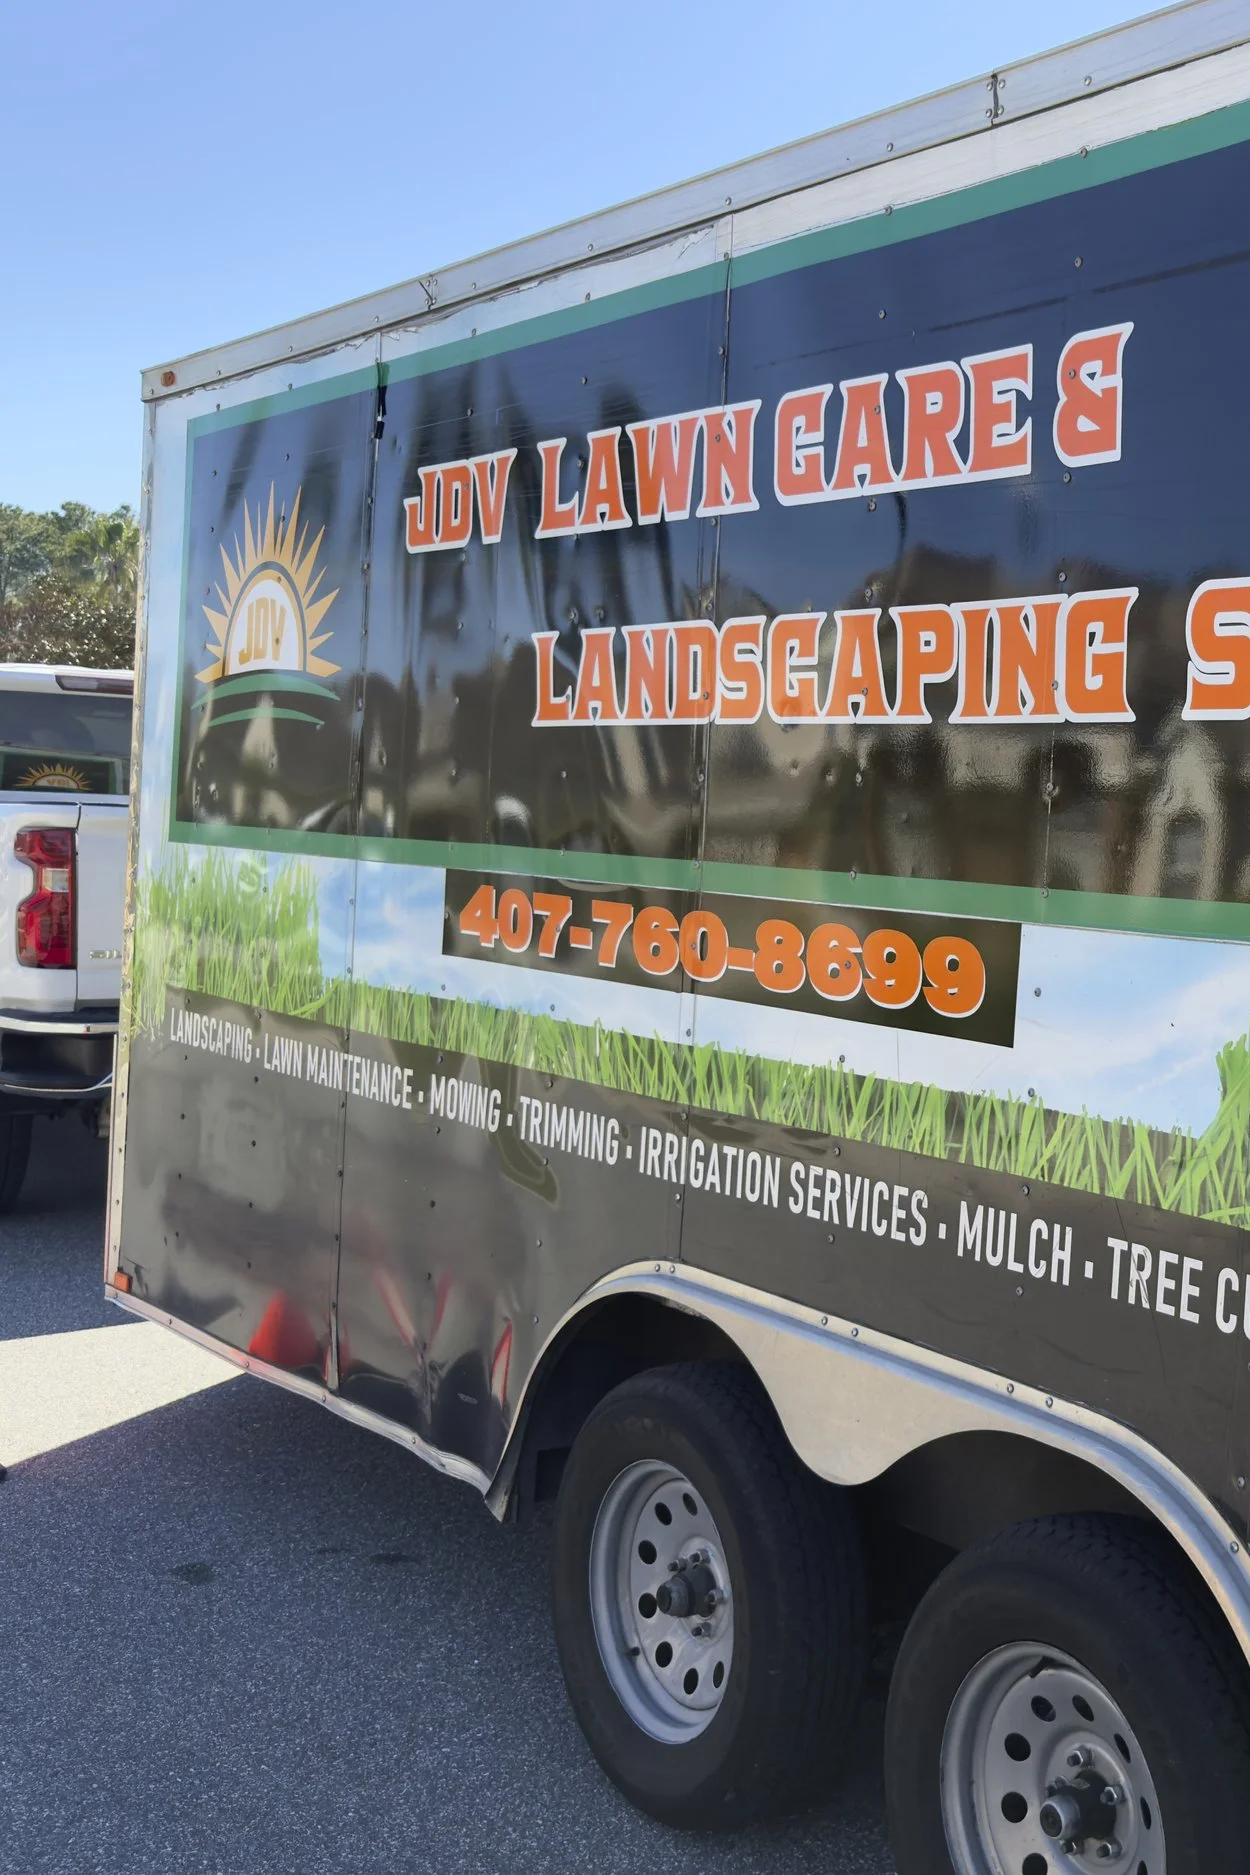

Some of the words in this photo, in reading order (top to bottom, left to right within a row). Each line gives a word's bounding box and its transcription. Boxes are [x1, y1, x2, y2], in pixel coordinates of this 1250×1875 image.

[403, 448, 518, 554] JDV
[535, 398, 762, 540] LAWN
[773, 343, 1035, 508] CARE
[1052, 321, 1135, 468] &
[238, 597, 287, 665] JDV
[530, 586, 1140, 728] LANDSCAPING
[459, 884, 987, 1018] 407-760-8699
[170, 1007, 253, 1064] LANDSCAPING
[263, 1033, 303, 1079] LAWN
[306, 1044, 414, 1110] MAINTENANCE
[430, 1073, 502, 1133] MOWING
[520, 1096, 620, 1165] TRIMMING
[639, 1126, 781, 1208] IRRIGATION
[788, 1161, 929, 1246] SERVICES
[957, 1201, 1073, 1286] MULCH
[1107, 1236, 1202, 1325] TREE
